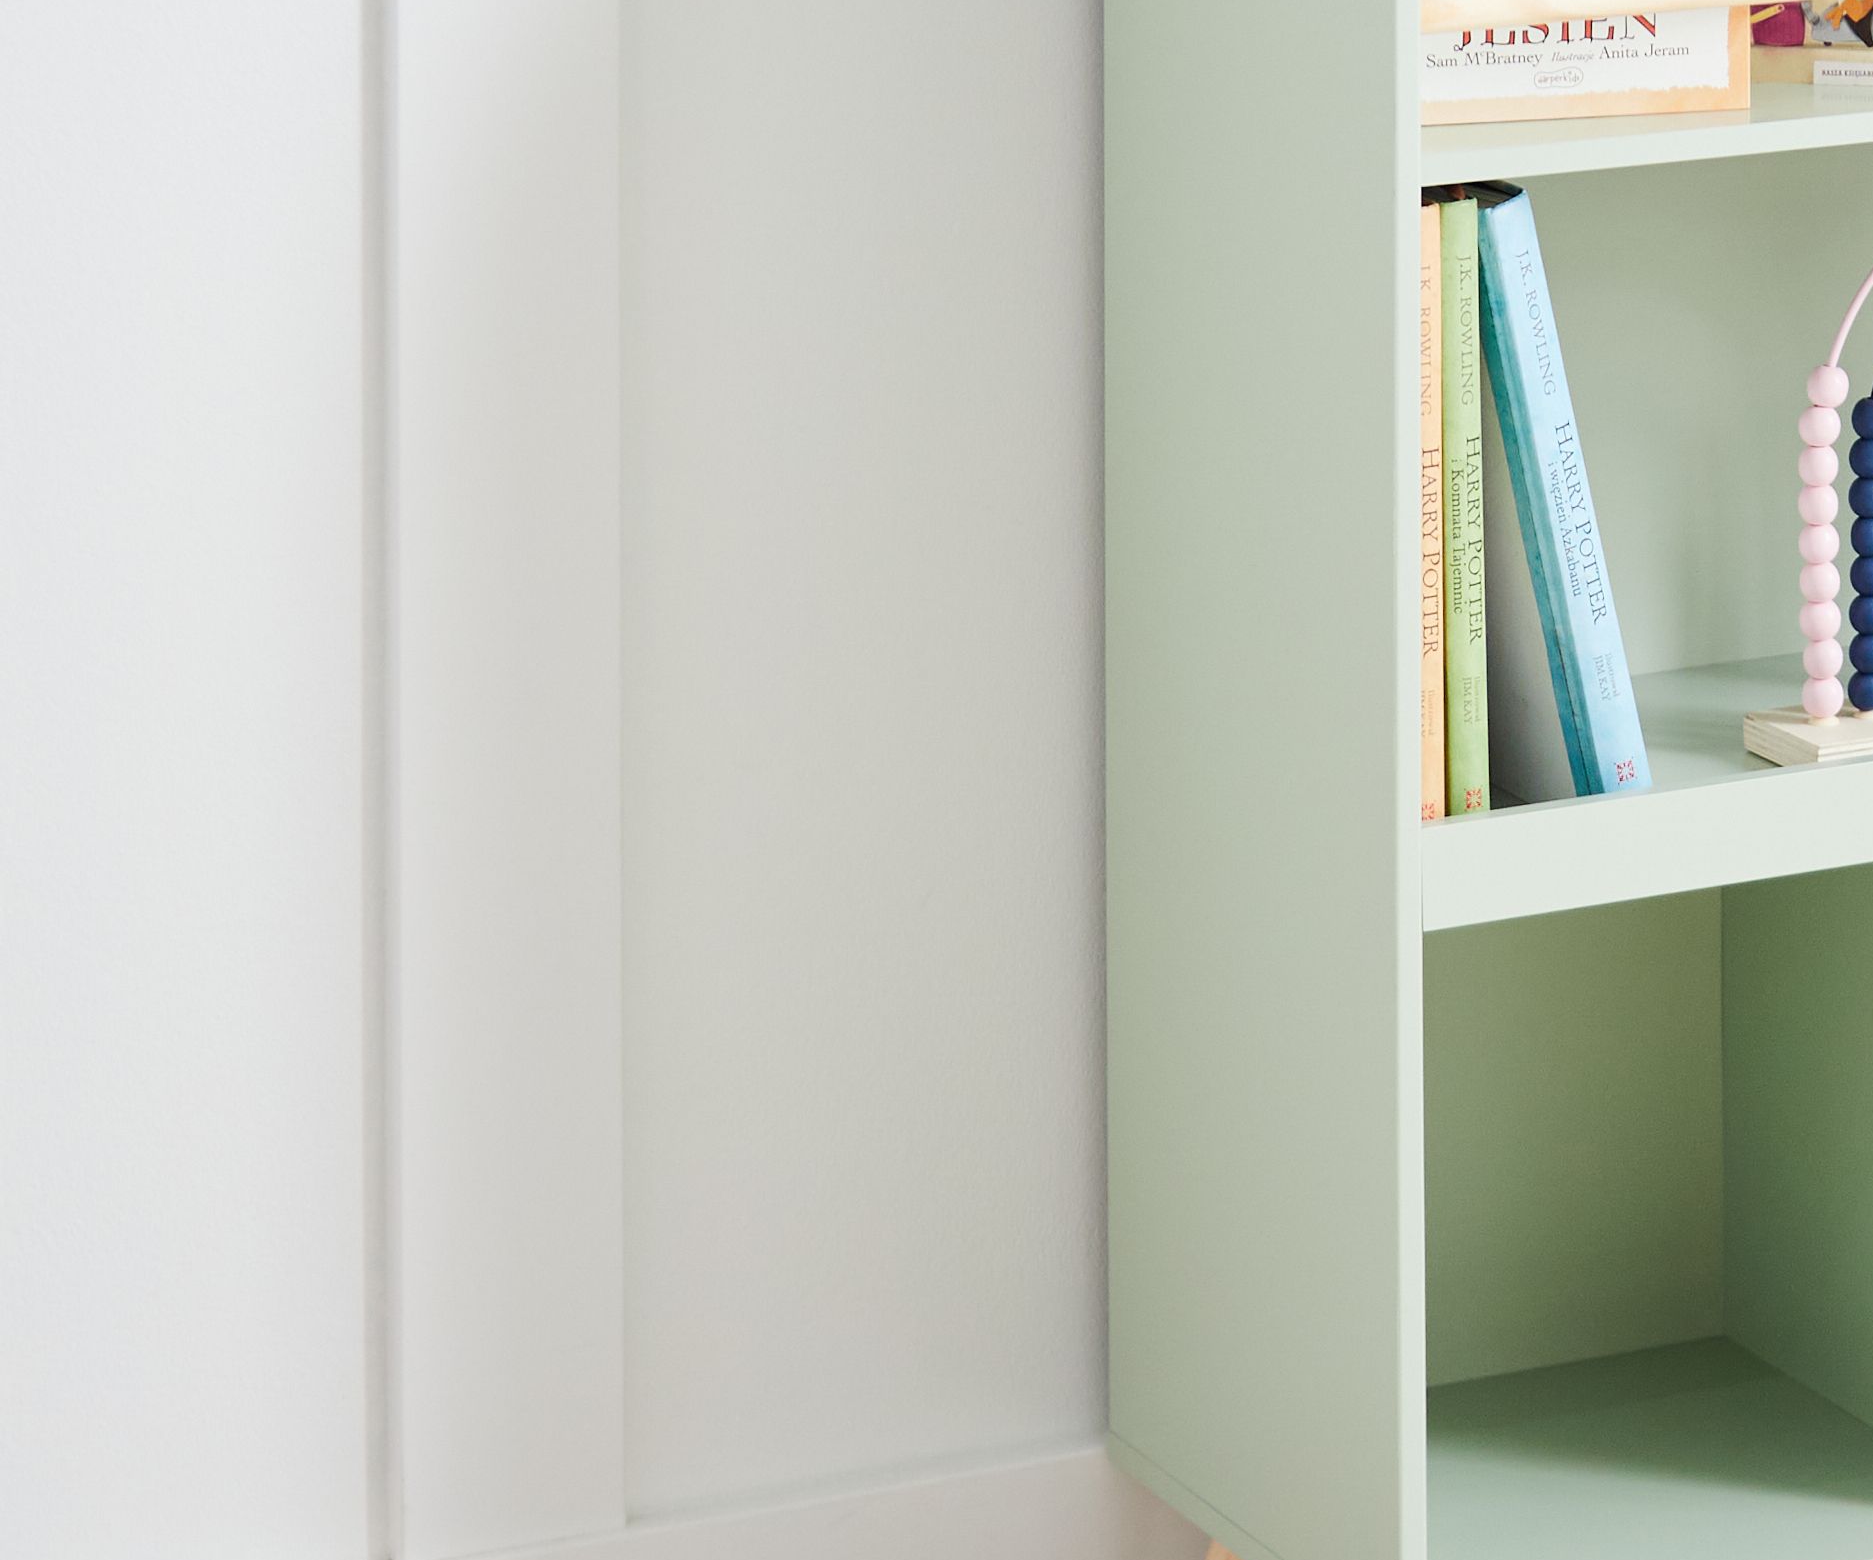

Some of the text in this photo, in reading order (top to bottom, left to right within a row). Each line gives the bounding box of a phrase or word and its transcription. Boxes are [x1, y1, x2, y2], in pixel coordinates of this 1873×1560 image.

[1425, 54, 1458, 68] Sam
[1598, 44, 1639, 60] Anita
[1644, 42, 1690, 58] Jeram
[1457, 255, 1474, 405] J.K. ROWLING
[1515, 250, 1557, 396] J.K. ROWLING
[1422, 447, 1441, 657] HARRY POTTER
[1451, 470, 1465, 540] Komnata
[1466, 436, 1483, 645] HARRY POTTER
[1555, 422, 1608, 625] HARRY POTTER
[1450, 545, 1466, 614] Tajemnic
[1560, 527, 1582, 597] Azkabanu
[1463, 699, 1474, 725] KAY
